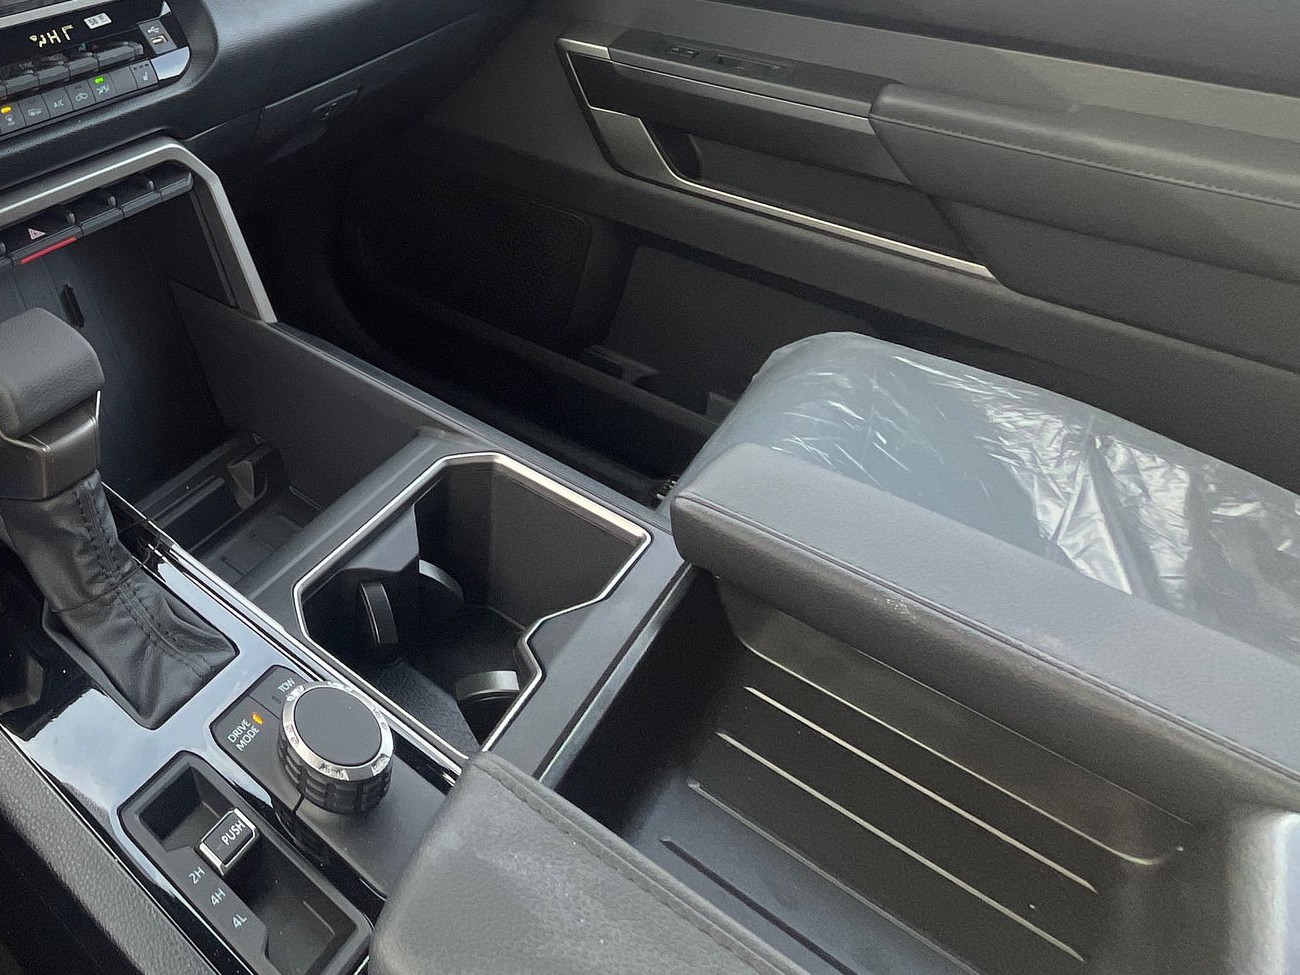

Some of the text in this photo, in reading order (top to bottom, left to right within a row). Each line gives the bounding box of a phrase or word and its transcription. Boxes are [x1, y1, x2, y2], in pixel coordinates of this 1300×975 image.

[277, 678, 296, 694] TOW
[227, 719, 251, 744] DRIVE
[236, 725, 260, 752] MODE
[221, 820, 246, 846] PUSH
[188, 866, 206, 884] 2H
[210, 888, 227, 906] 4H
[232, 913, 248, 929] 4L
